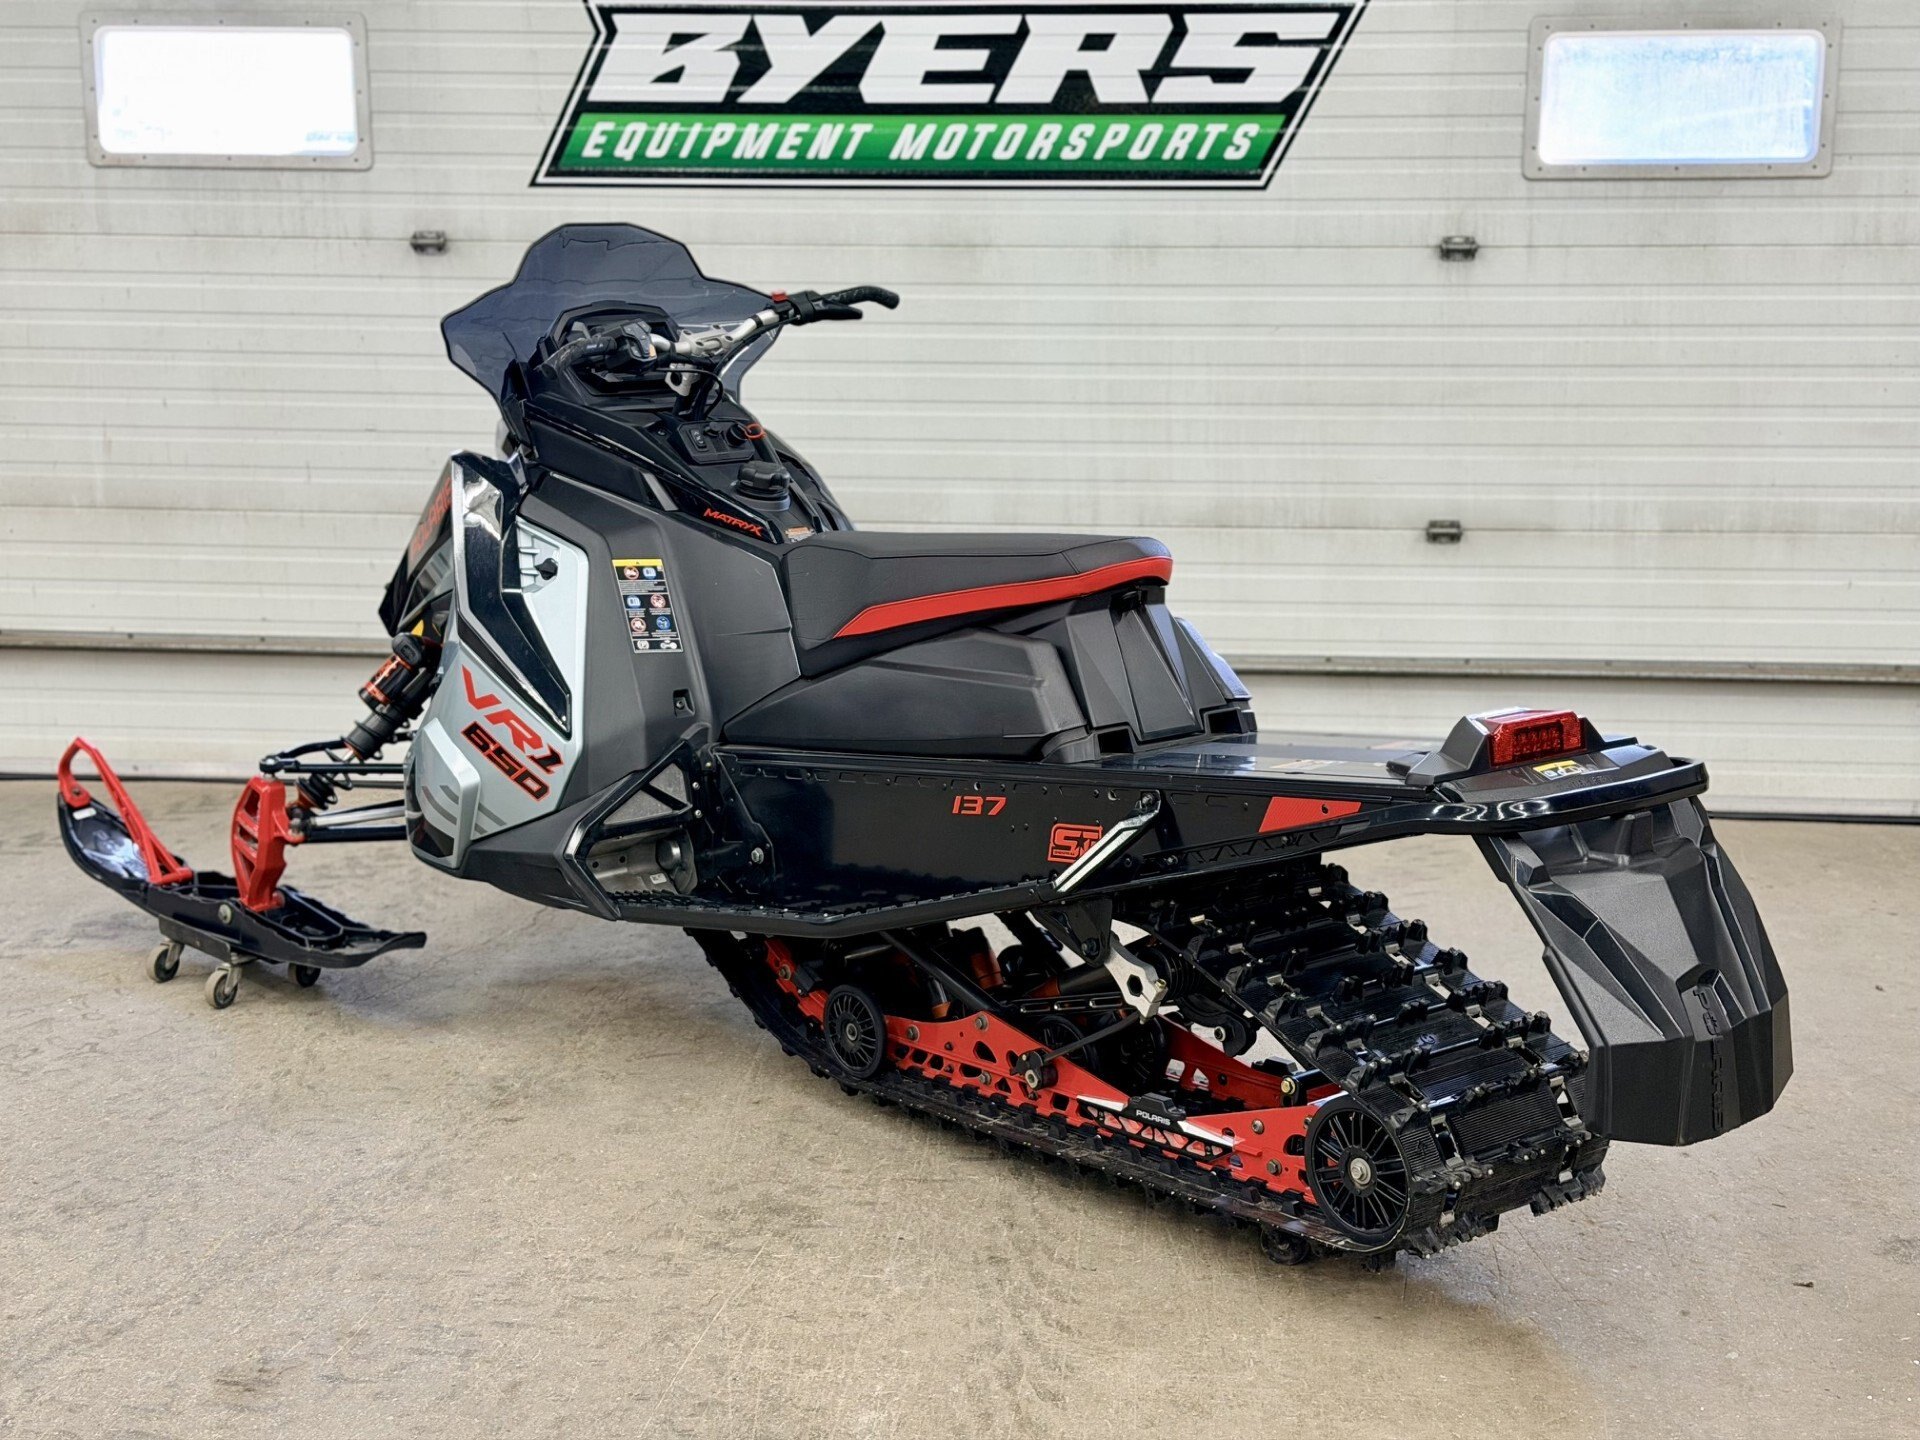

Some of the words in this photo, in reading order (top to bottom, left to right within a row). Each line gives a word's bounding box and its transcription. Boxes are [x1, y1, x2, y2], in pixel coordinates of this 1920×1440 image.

[586, 14, 1339, 104] BYERS
[582, 122, 873, 161] EQUIPMENT
[889, 123, 1261, 161] MOTORSPORTS
[703, 508, 763, 536] MATRYX
[461, 663, 564, 775] VR1
[461, 721, 550, 801] 650
[952, 797, 1006, 815] 137
[1136, 1110, 1171, 1126] POLARIS
